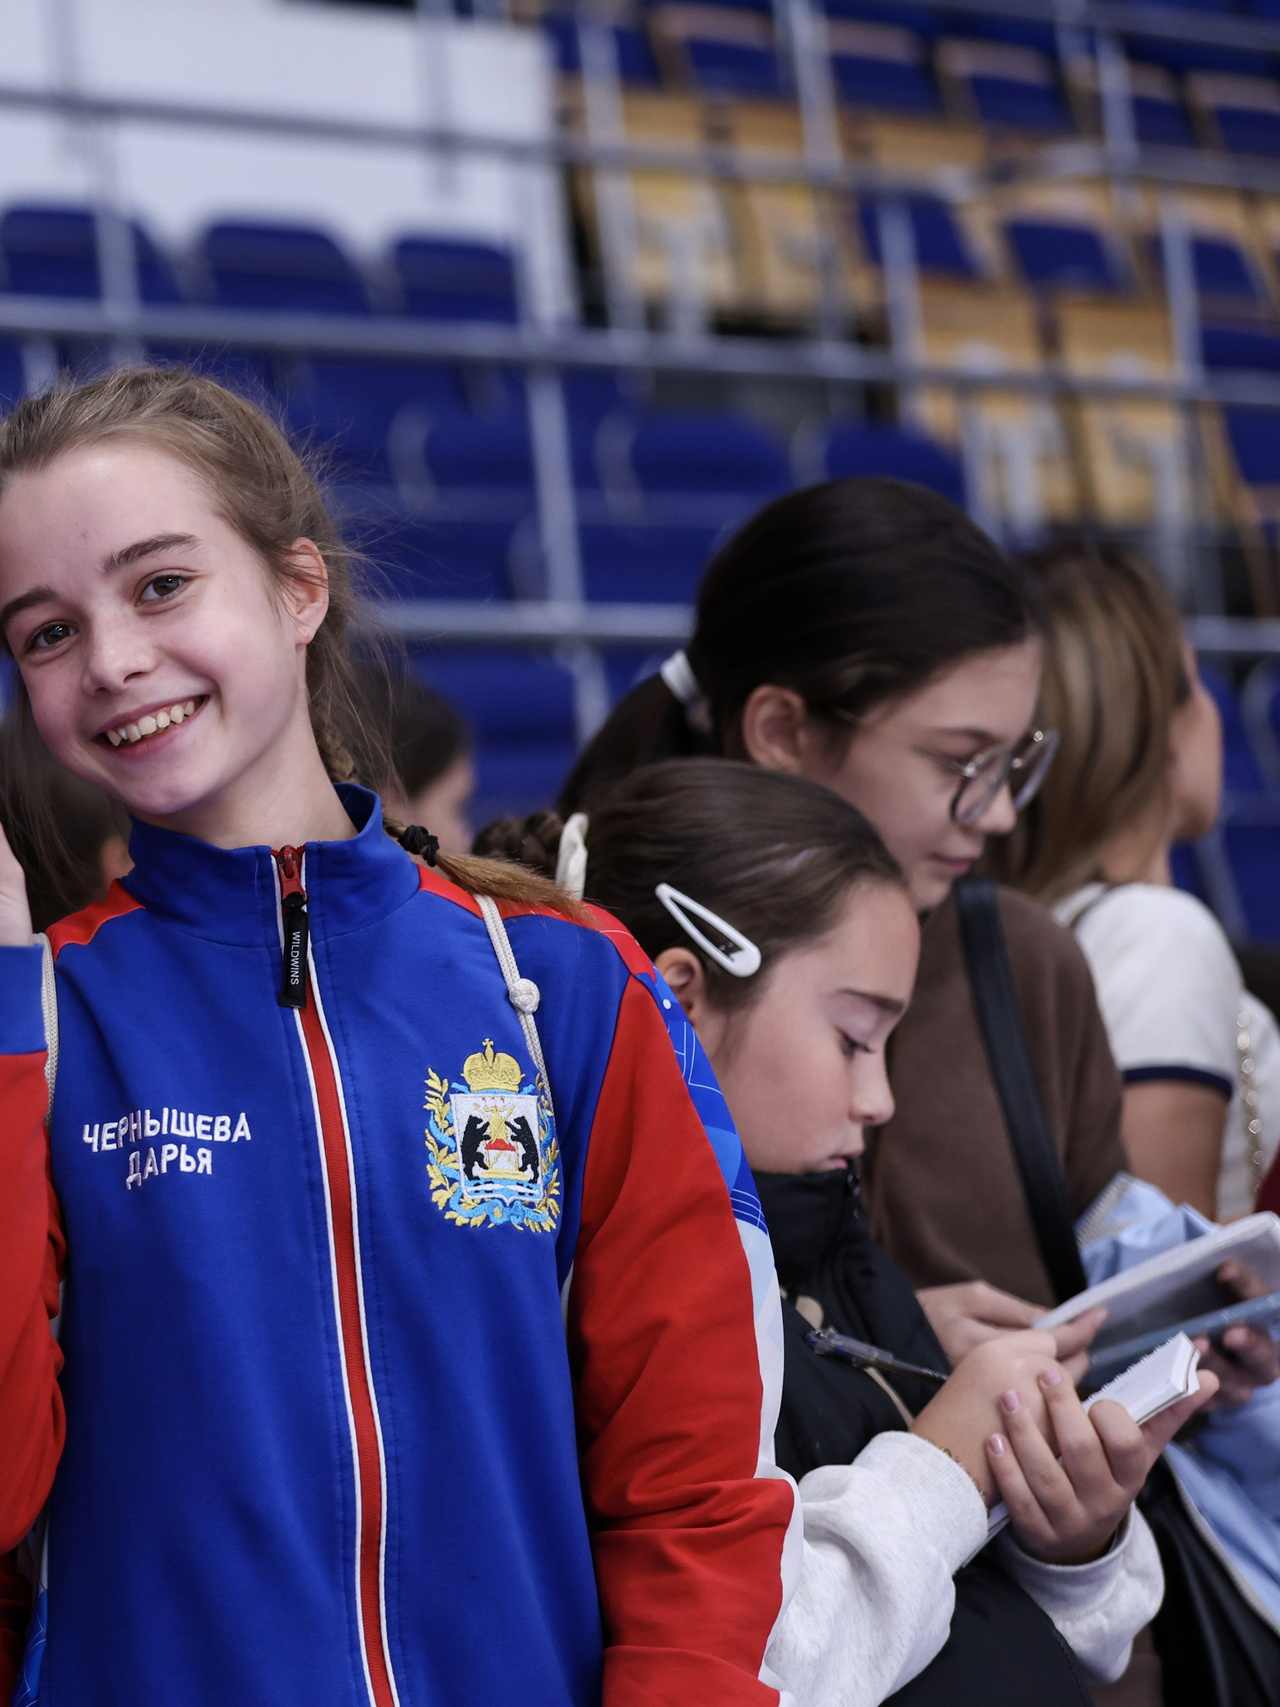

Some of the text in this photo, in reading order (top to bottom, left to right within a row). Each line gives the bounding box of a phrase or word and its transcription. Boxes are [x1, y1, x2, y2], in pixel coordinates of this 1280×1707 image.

[290, 930, 301, 986] WILDWINS
[82, 1107, 252, 1153] ЧЕРНЫШЕВА
[126, 1143, 213, 1190] ДАРЬЯ
